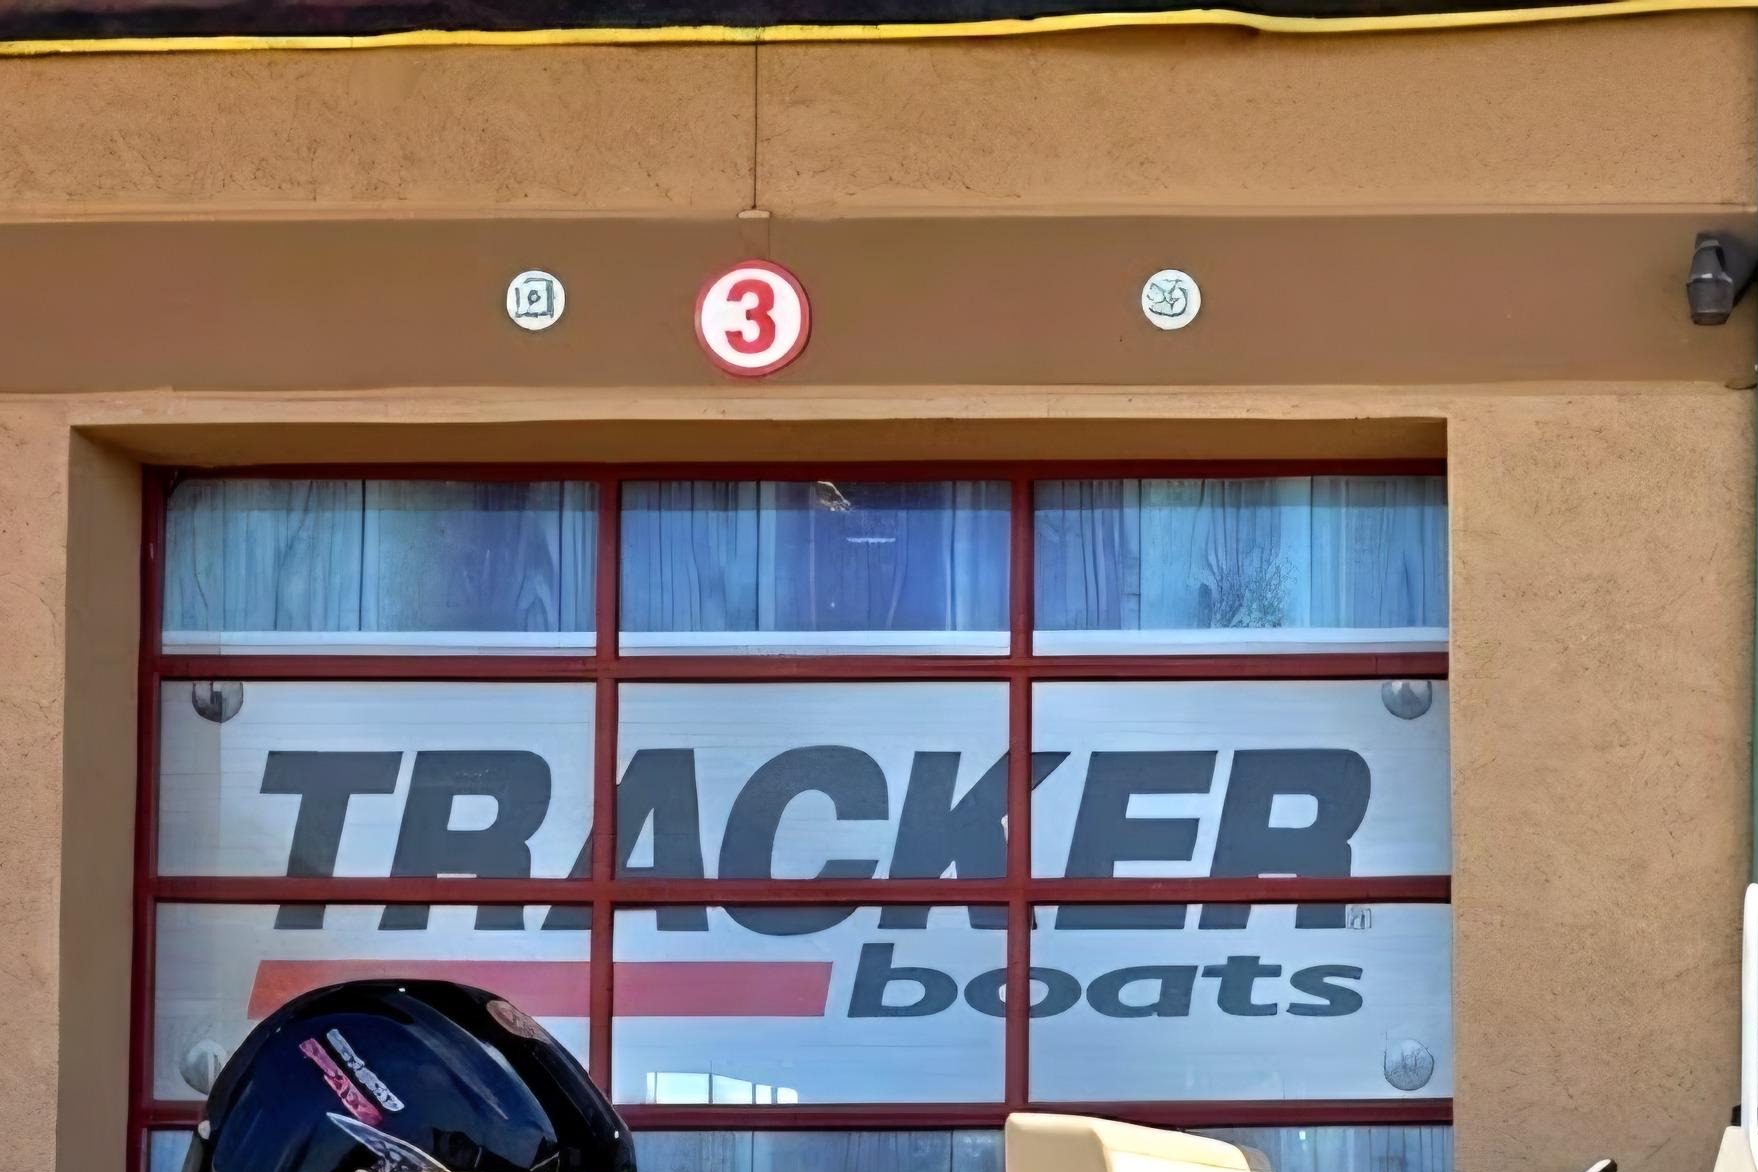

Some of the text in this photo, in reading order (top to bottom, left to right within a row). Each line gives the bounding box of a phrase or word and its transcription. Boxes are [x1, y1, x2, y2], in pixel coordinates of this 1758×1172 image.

[724, 278, 776, 355] 3
[259, 744, 1372, 935] TRACKER
[847, 942, 1363, 1019] boats
